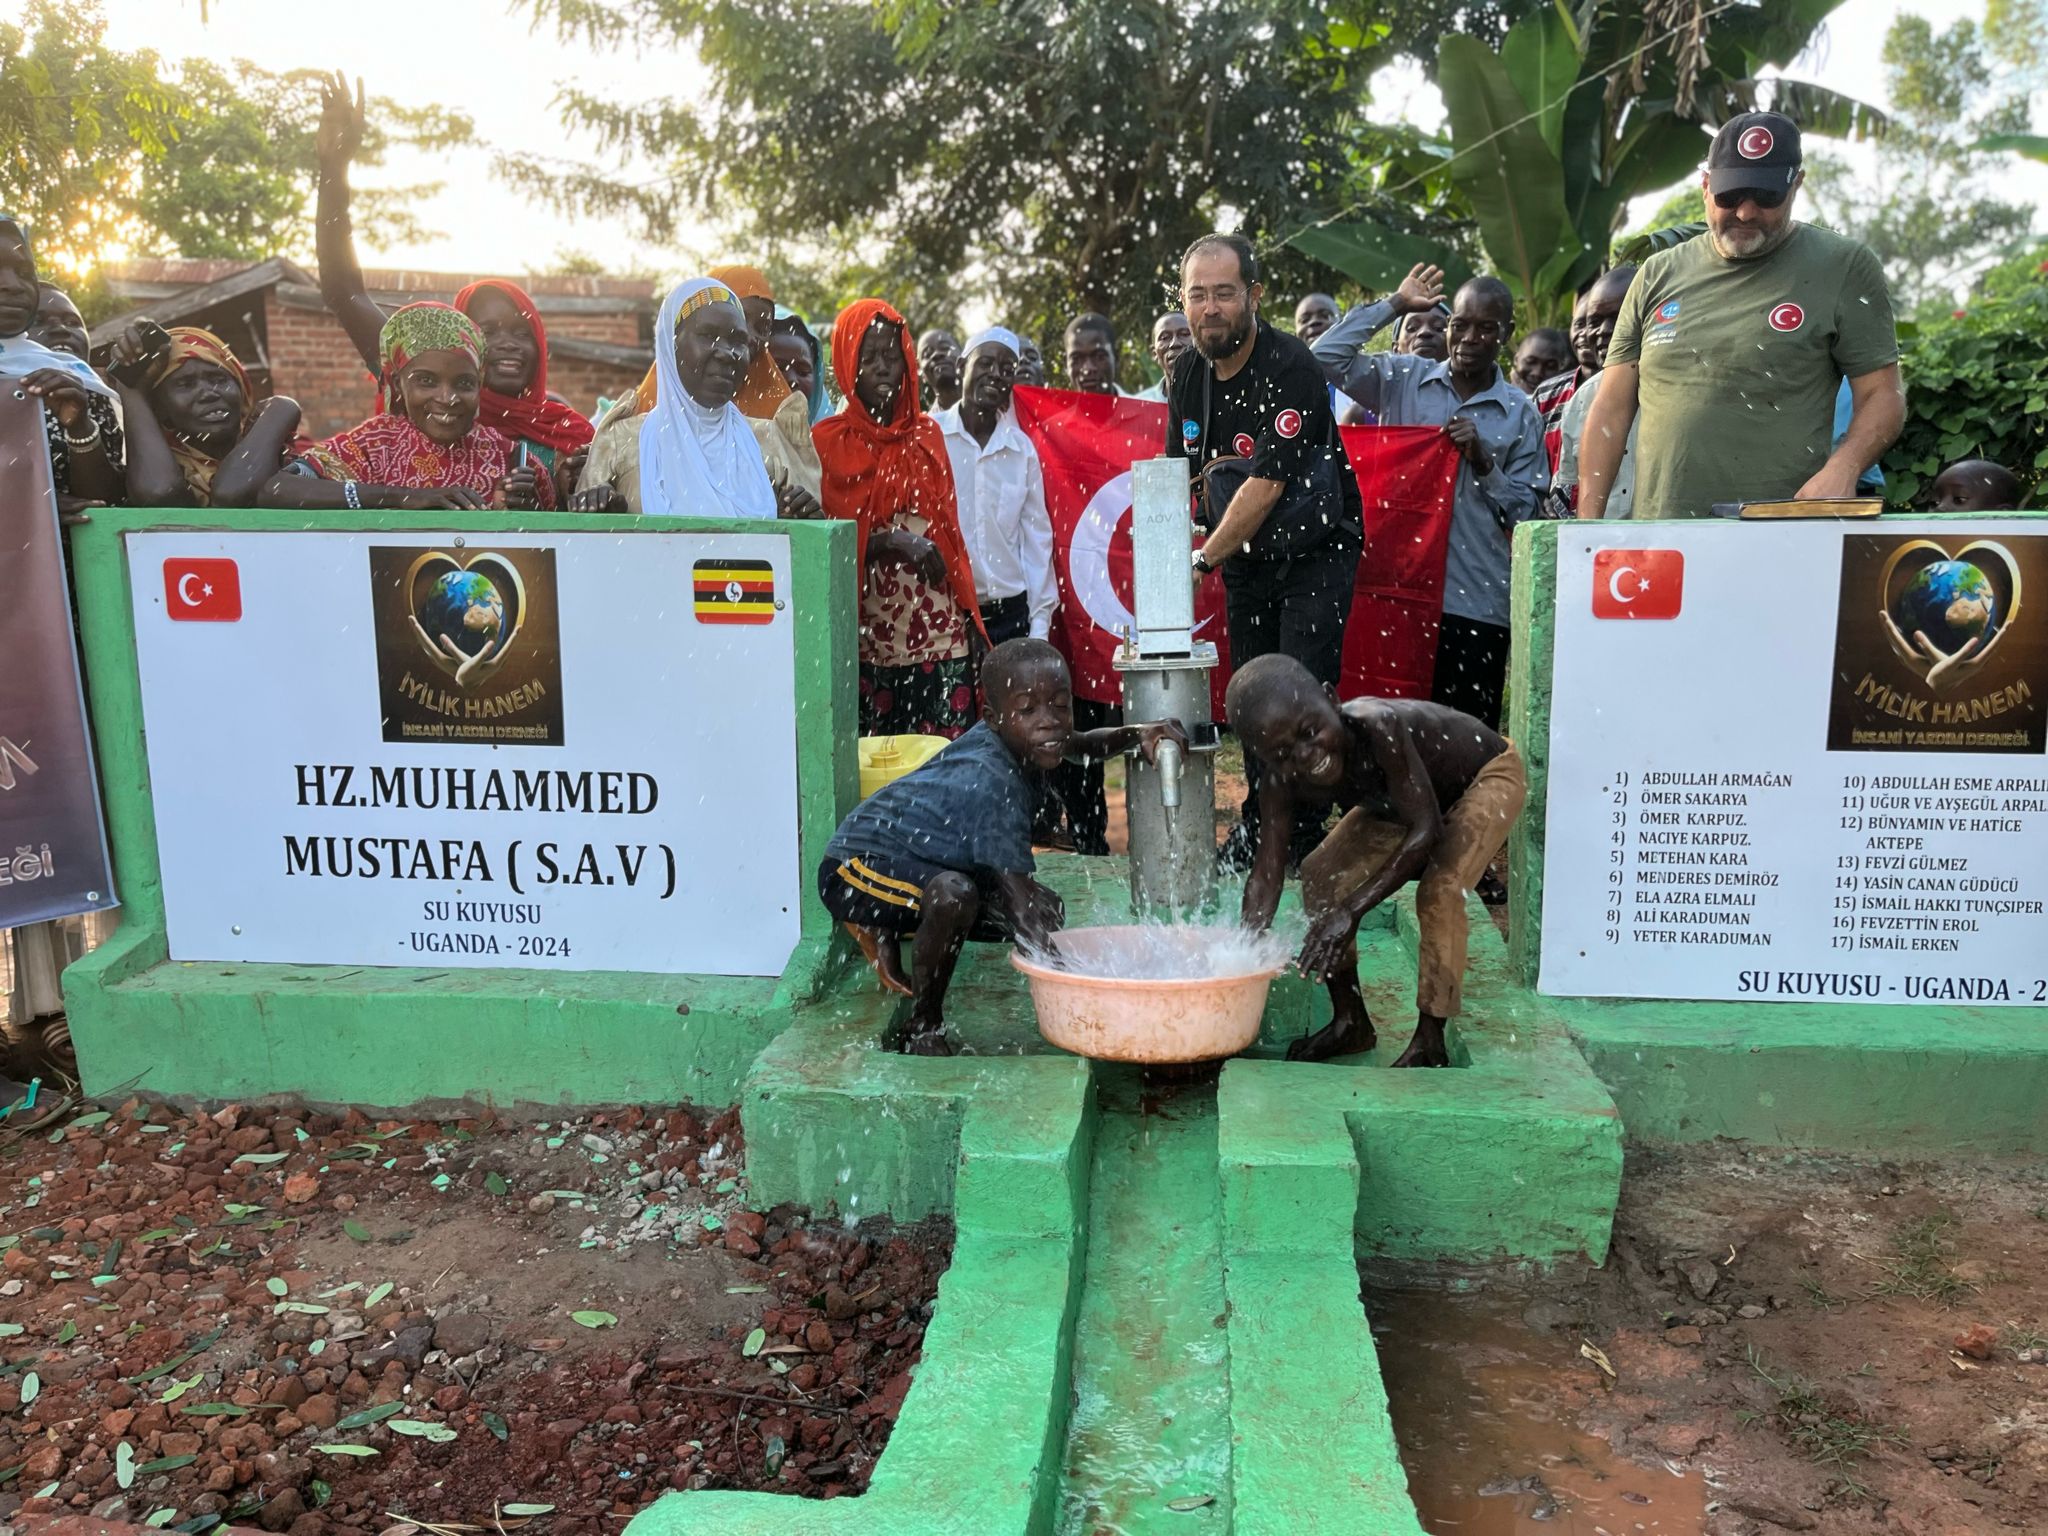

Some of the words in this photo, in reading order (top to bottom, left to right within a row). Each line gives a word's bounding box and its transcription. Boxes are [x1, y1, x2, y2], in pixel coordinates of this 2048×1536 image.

[398, 671, 460, 718] İYİLİK
[464, 678, 546, 719] HANEM
[1854, 672, 1928, 723] İYİLİK
[1931, 678, 2032, 724] HANEM
[402, 721, 444, 737] İNSANİ
[445, 724, 495, 738] YARDIM
[495, 724, 549, 739] DERNEĞİ
[1852, 728, 1902, 745] İNSANİ
[1905, 731, 1964, 746] YARDIM
[1965, 729, 2028, 747] DERNEĞİ
[1615, 771, 1629, 787] 1)
[1642, 772, 1717, 785] ABDULLAH
[1720, 771, 1793, 787] ARMAĞAN
[1843, 776, 1866, 792] 10)
[1871, 776, 1950, 790] ABDULLAH
[1954, 778, 1992, 791] ESME
[294, 764, 659, 814] HZ.MUHAMMED
[1613, 791, 1627, 807] 2)
[1641, 789, 1681, 804] ÖMER
[1684, 792, 1748, 806] SAKARYA
[1842, 795, 1864, 812] 11)
[1870, 793, 1910, 809] UĞUR
[1914, 797, 1932, 809] VE
[1935, 795, 1998, 814] AYŞEGÜL
[1612, 811, 1626, 827] 3)
[1640, 809, 1680, 824] ÖMER
[1687, 813, 1747, 826] KARPUZ.
[1840, 816, 1863, 832] 12)
[1868, 814, 1944, 830] BÜNYAMIN
[1948, 818, 1967, 831] VE
[1970, 816, 2022, 832] HATİCE
[1611, 831, 1625, 846] 4)
[1639, 832, 1688, 844] NACIYE
[1691, 832, 1751, 846] KARPUZ.
[1866, 837, 1923, 850] AKTEPE
[283, 835, 494, 882] MUSTAFA
[1610, 850, 1624, 866] 5)
[1638, 851, 1705, 864] METEHAN
[1709, 852, 1748, 865] KARA
[1836, 856, 1859, 872] 13)
[1865, 854, 1905, 869] FEVZİ
[1909, 855, 1968, 871] GÜLMEZ
[1609, 870, 1623, 886] 6)
[1636, 871, 1711, 885] MENDERES
[1714, 870, 1779, 886] DEMİRÖZ
[1835, 876, 1858, 892] 14)
[1864, 874, 1903, 889] YASİN
[1907, 878, 1956, 891] CANAN
[1959, 876, 2018, 892] GÜDÜCÜ
[1608, 890, 1622, 906] 7)
[1635, 891, 1661, 903] ELA
[1664, 892, 1700, 905] AZRA
[1704, 893, 1756, 906] ELMALI
[1833, 896, 1856, 912] 15)
[1862, 894, 1910, 910] İSMAİL
[1914, 899, 1960, 911] HAKKI
[1964, 900, 2043, 916] TUNÇSIPER
[423, 901, 450, 921] SU
[456, 902, 541, 925] KUYUSU
[1607, 910, 1621, 925] 8)
[1633, 908, 1656, 923] ALİ
[1660, 911, 1750, 925] KARADUMAN
[1832, 916, 1855, 931] 16)
[1860, 915, 1938, 930] FEVZETTİN
[1942, 919, 1979, 932] EROL
[410, 932, 500, 955] UGANDA
[518, 936, 572, 958] 2024
[1606, 929, 1620, 944] 9)
[1633, 930, 1677, 943] YETER
[1680, 932, 1771, 946] KARADUMAN
[1831, 936, 1853, 951] 17)
[1859, 934, 1907, 950] İSMAİL
[1911, 938, 1959, 951] ERKEN
[1737, 970, 1769, 992] SU
[1776, 972, 1881, 997] KUYUSU
[1904, 976, 2010, 1001] UGANDA
